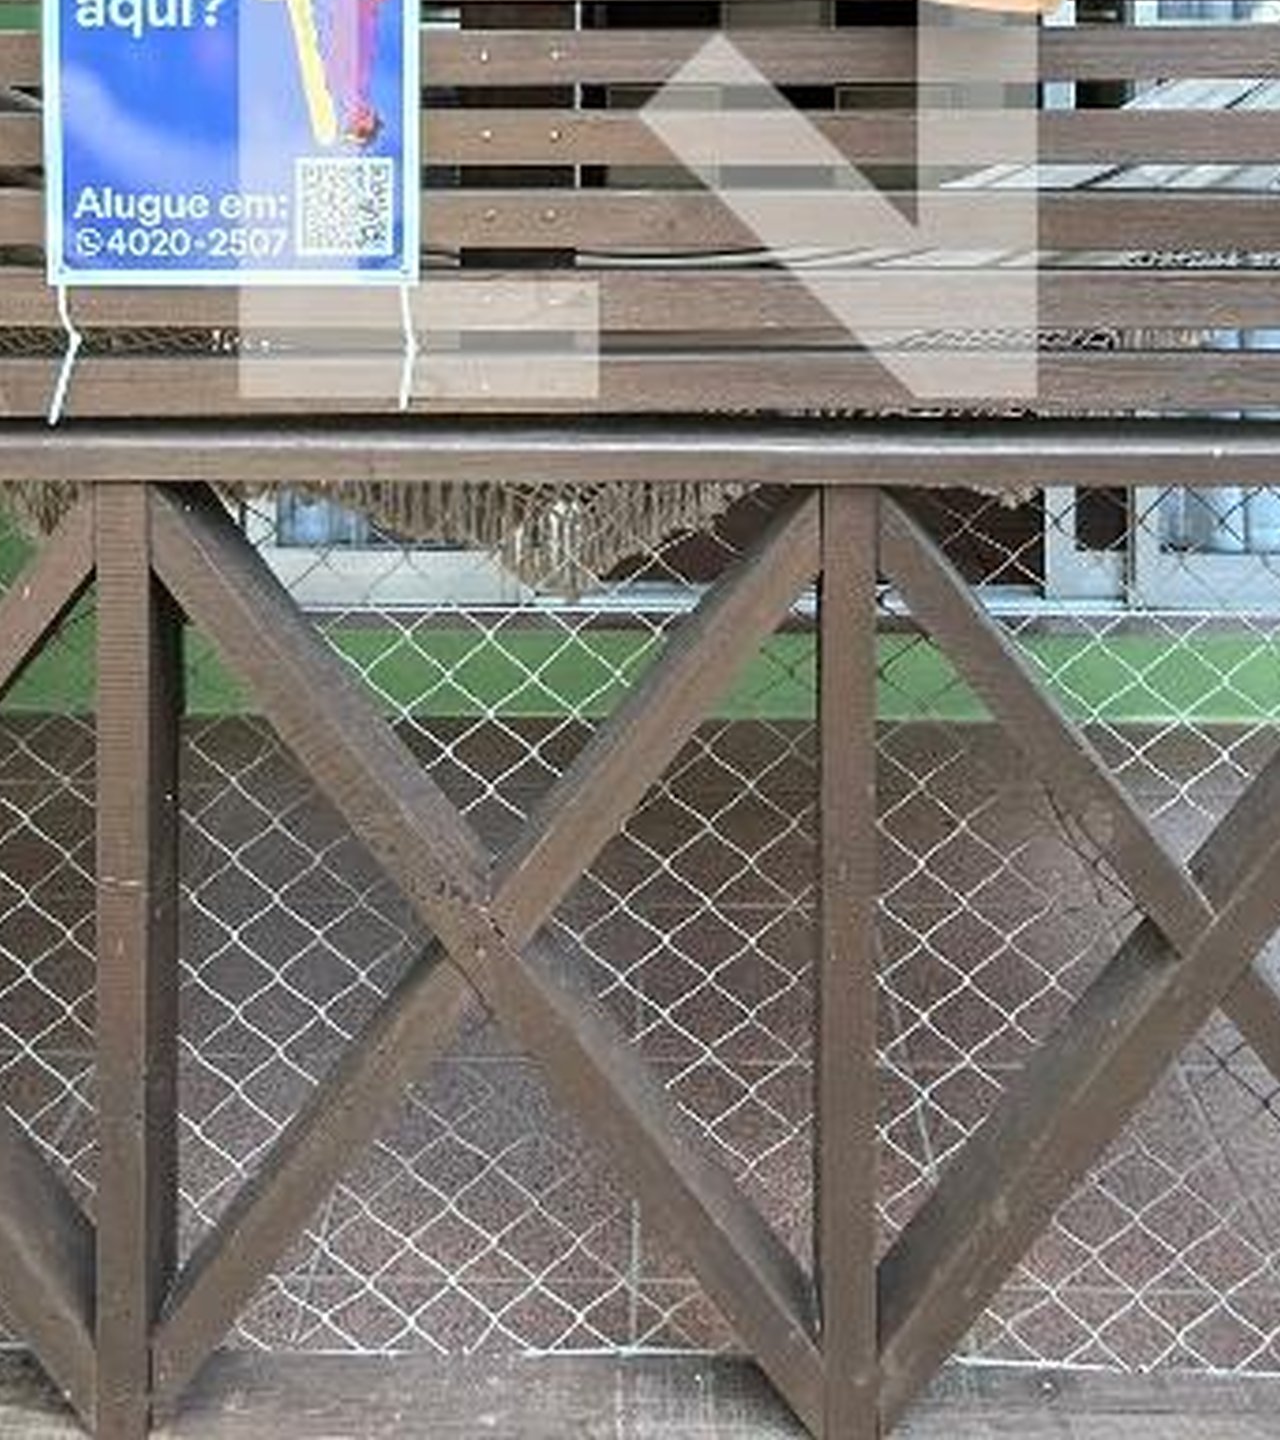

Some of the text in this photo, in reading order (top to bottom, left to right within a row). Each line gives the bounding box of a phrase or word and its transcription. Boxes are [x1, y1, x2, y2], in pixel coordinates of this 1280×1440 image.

[73, 187, 288, 226] Alugue em:
[106, 228, 288, 257] 4020-2507
